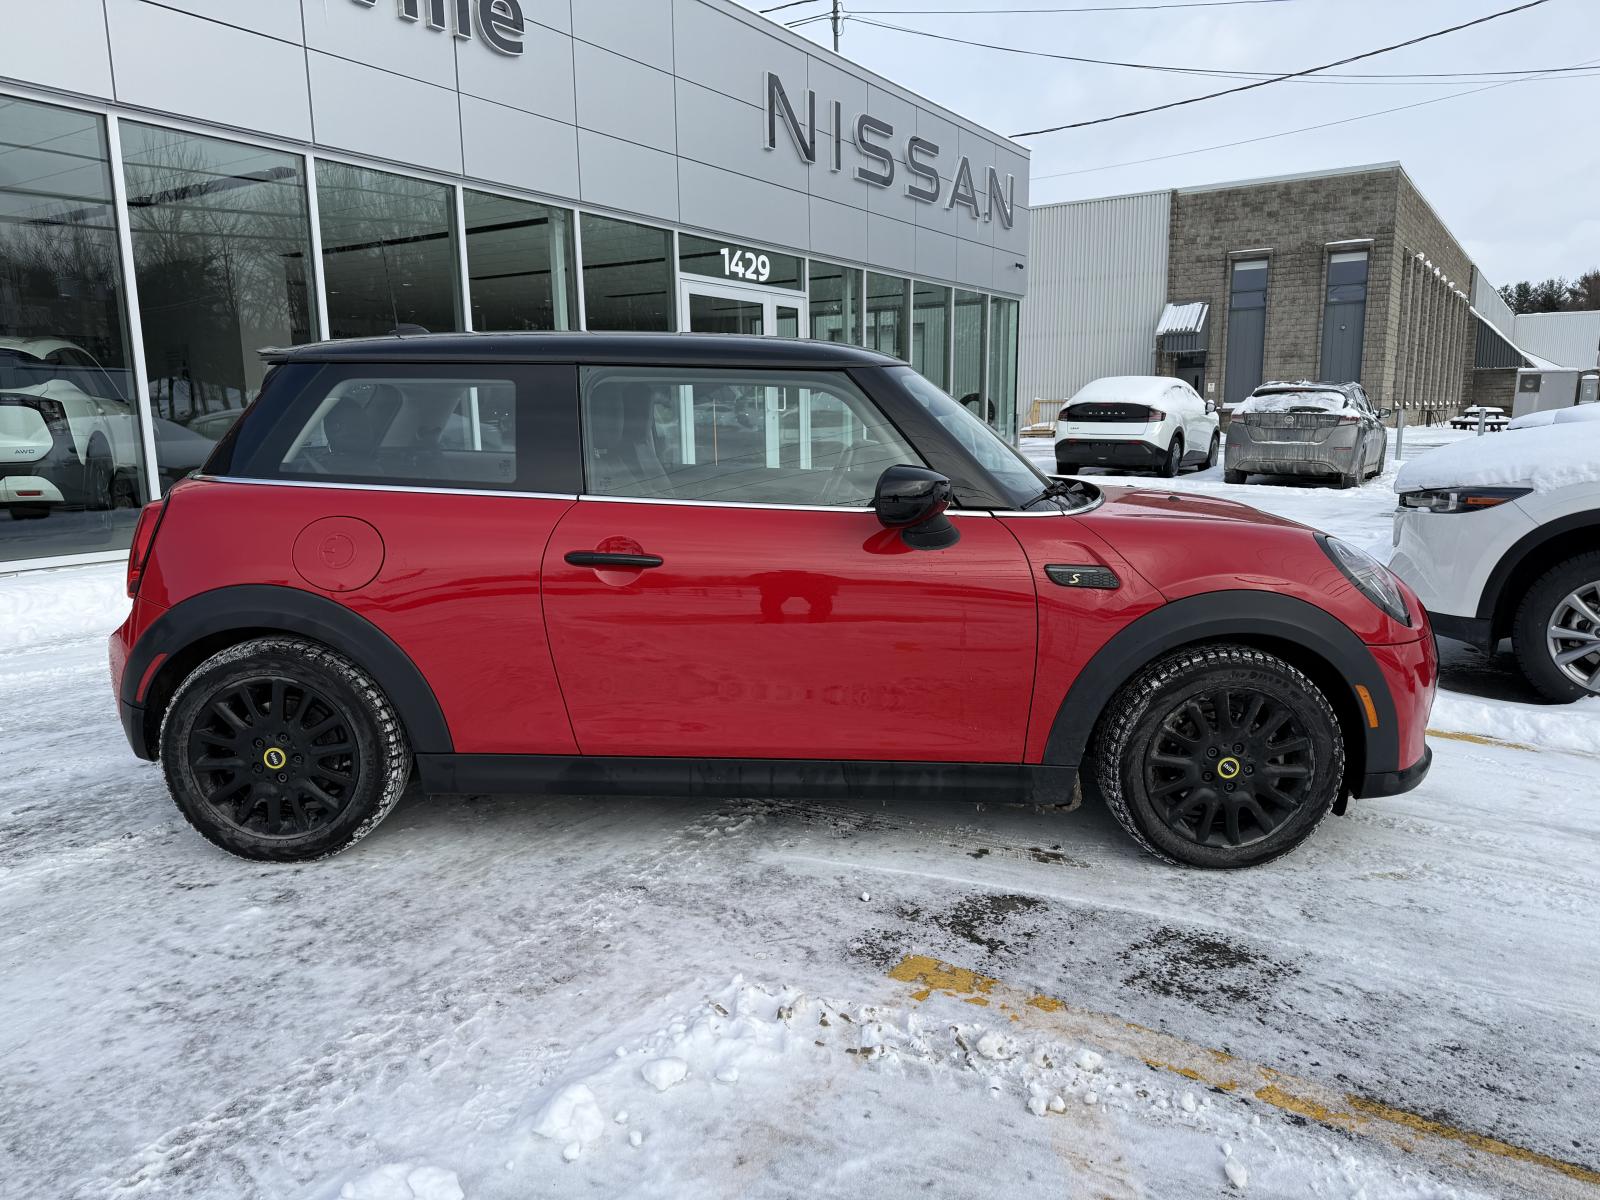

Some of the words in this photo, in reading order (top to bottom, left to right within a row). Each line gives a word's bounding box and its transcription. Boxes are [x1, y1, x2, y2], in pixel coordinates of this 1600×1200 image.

[763, 71, 1014, 229] NISSAN
[720, 247, 770, 282] 1429
[1068, 573, 1081, 584] S
